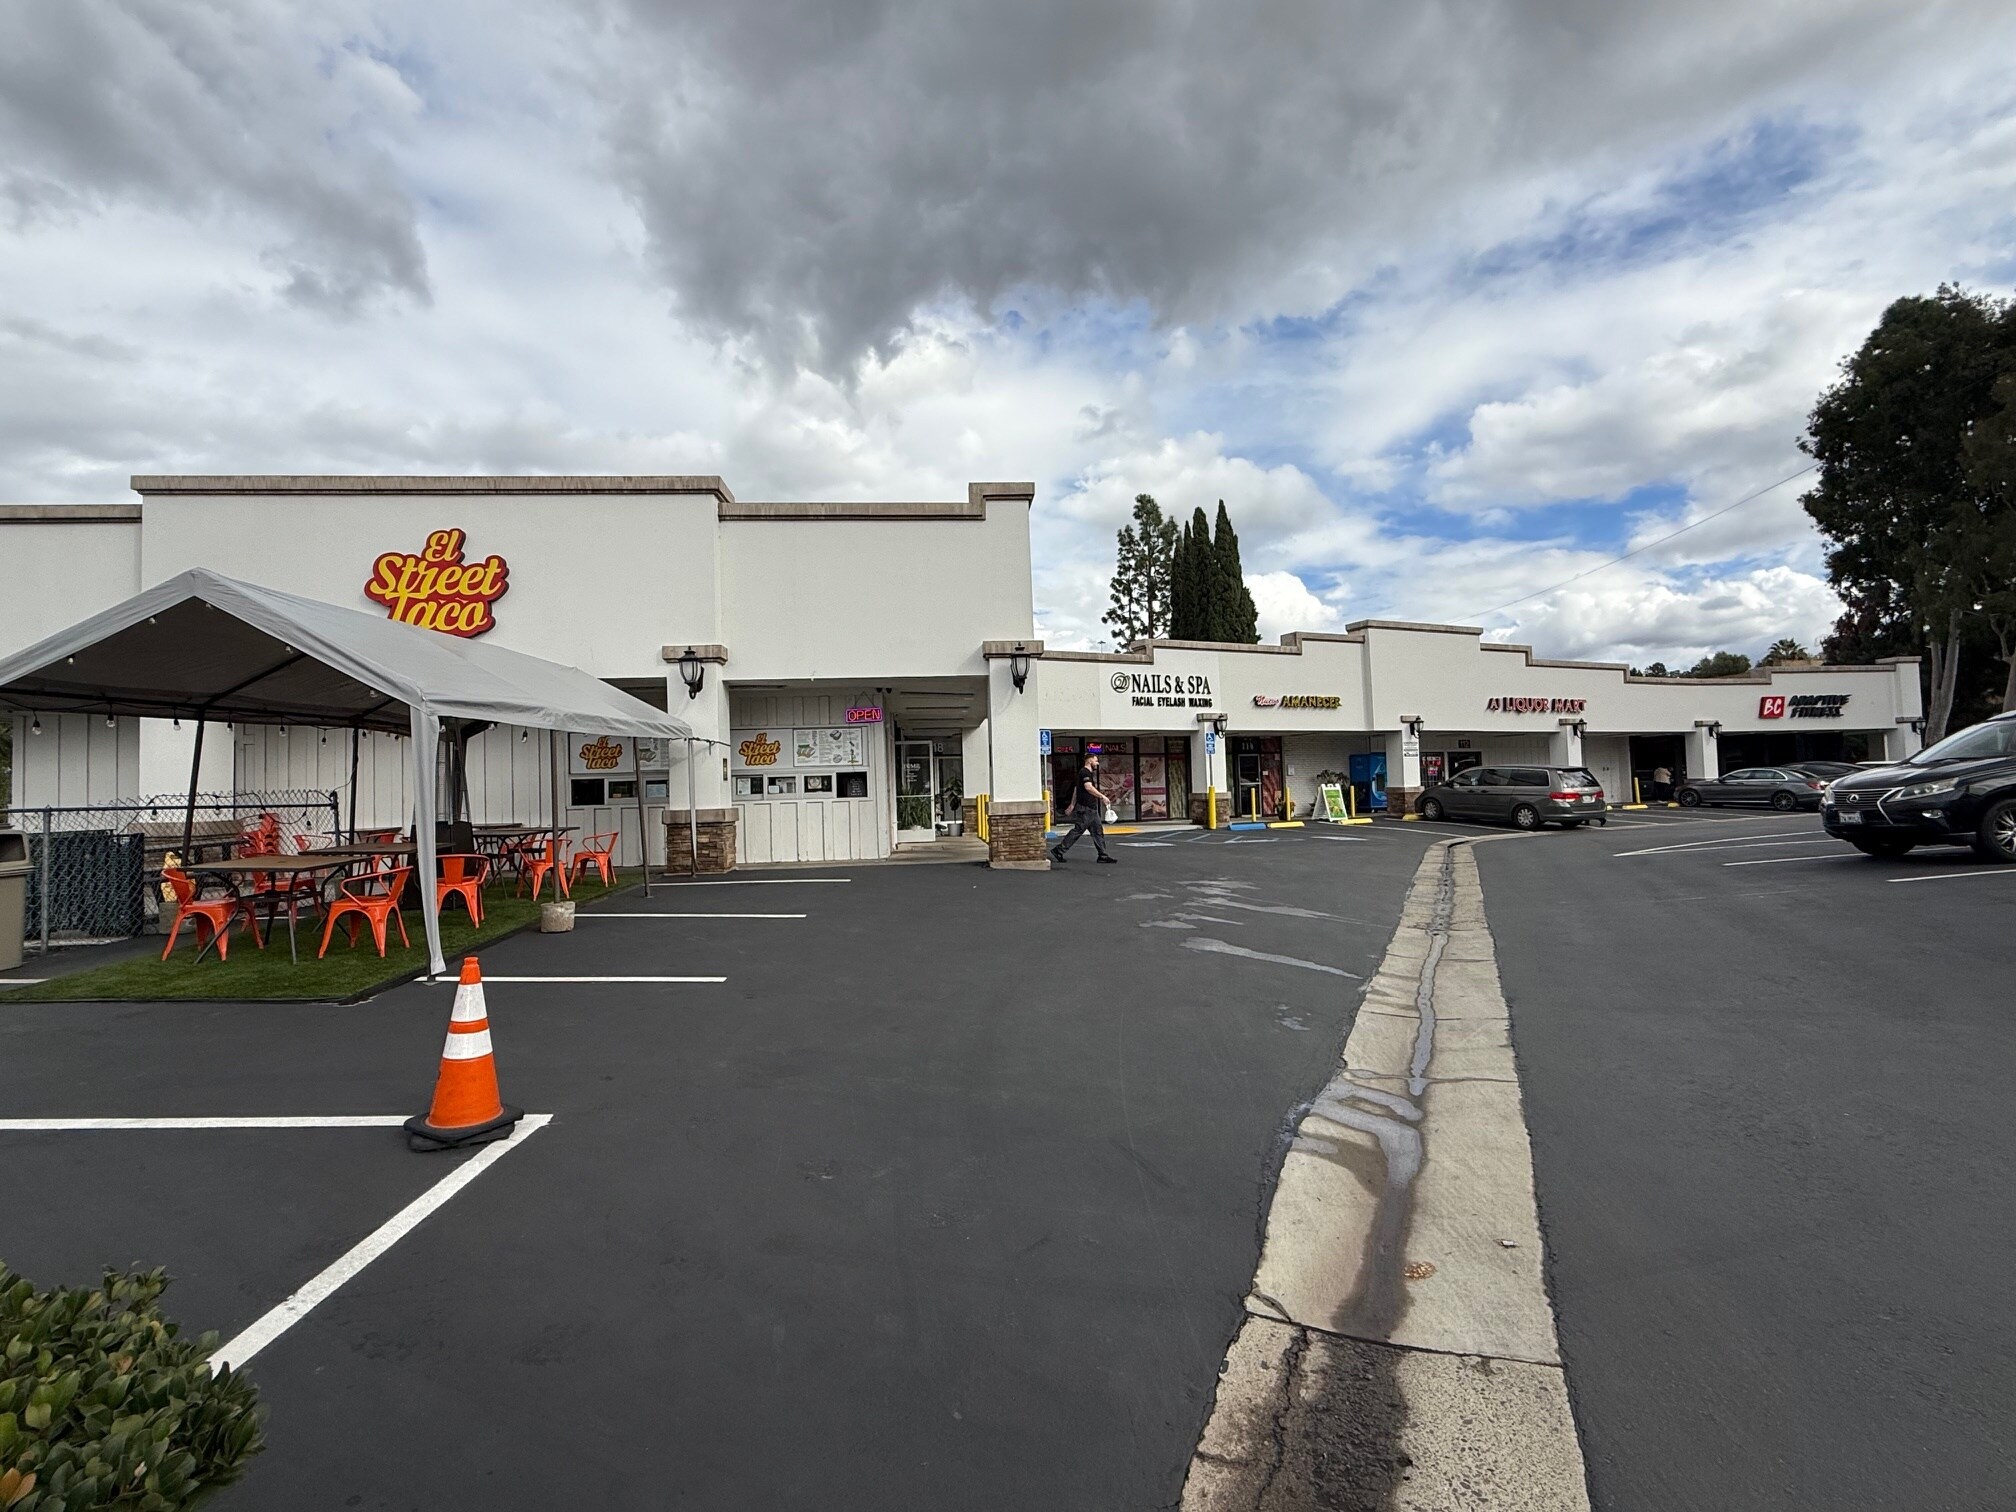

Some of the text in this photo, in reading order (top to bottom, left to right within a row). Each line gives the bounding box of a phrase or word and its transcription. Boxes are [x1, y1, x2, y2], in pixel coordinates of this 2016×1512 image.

[425, 530, 459, 562] El
[369, 555, 502, 596] Street
[385, 591, 488, 631] Taco
[1131, 674, 1172, 694] NAILS
[1174, 675, 1185, 694] &
[1187, 675, 1211, 695] SPA
[1132, 696, 1213, 708] FACIAL EYELASH WAXING
[1281, 695, 1342, 709] AMANECER
[1502, 697, 1549, 713] LIQUOR
[1551, 698, 1587, 713] MART
[1764, 698, 1782, 715] BC
[848, 710, 881, 721] OPEN
[756, 733, 767, 745] El
[580, 745, 622, 759] Street
[740, 741, 780, 755] Street
[1105, 744, 1126, 752] NAILS
[587, 757, 617, 769] Taco
[745, 753, 776, 766] Taco
